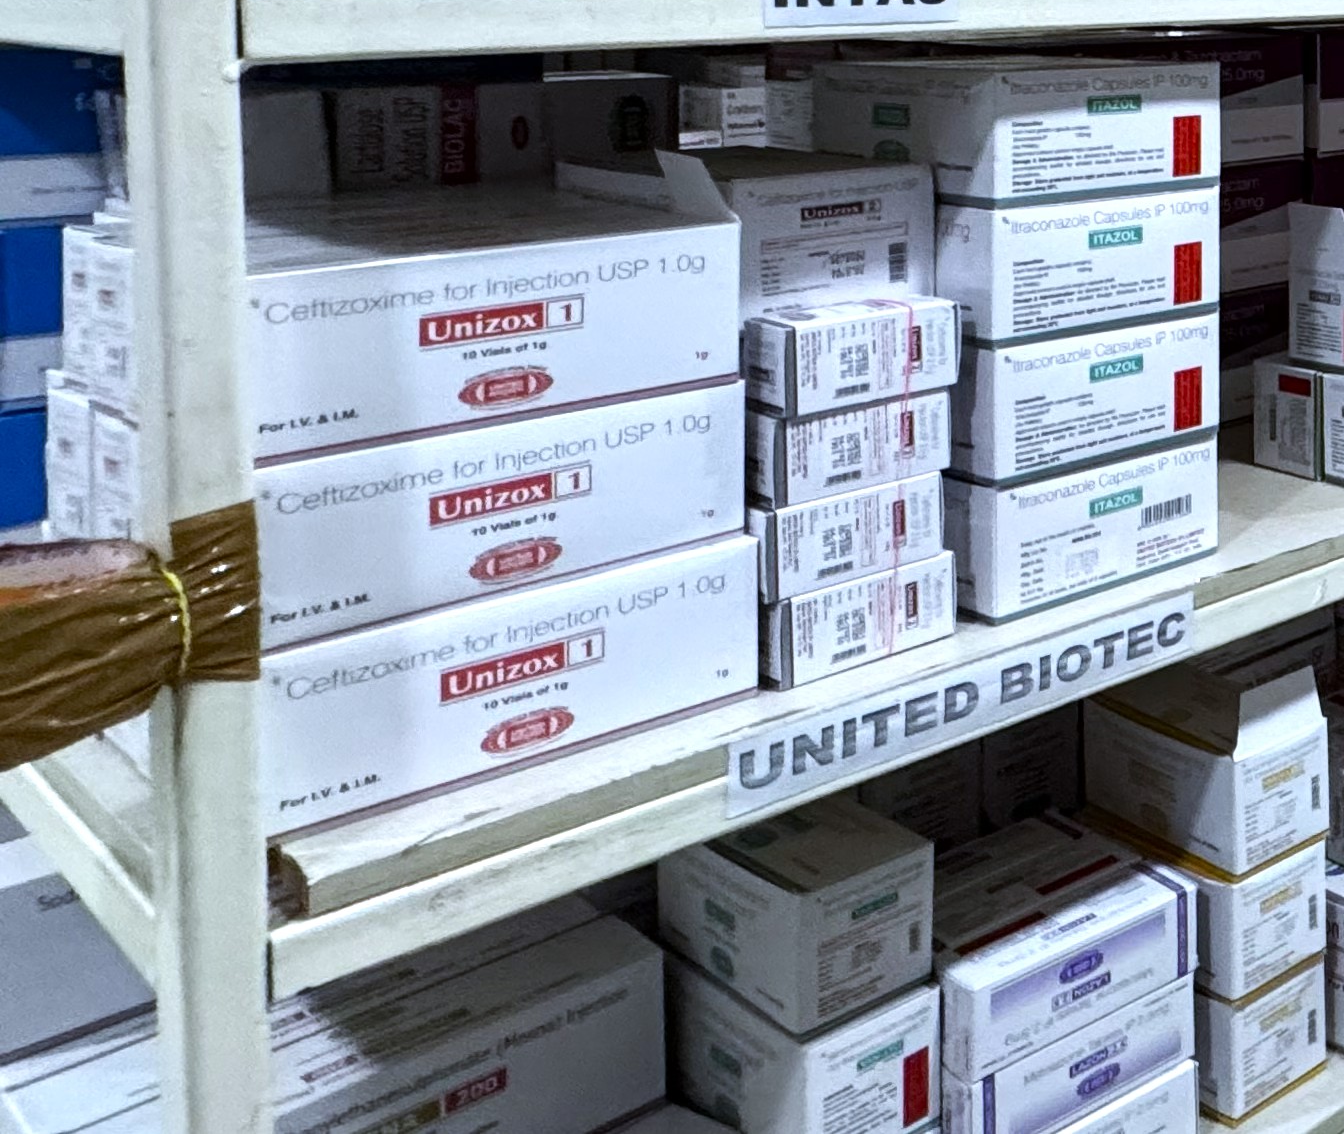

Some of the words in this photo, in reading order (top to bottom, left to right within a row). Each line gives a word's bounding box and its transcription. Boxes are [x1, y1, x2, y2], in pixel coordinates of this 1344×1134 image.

[1092, 77, 1150, 92] Capsules
[1170, 73, 1210, 89] 100mg
[1093, 97, 1137, 111] ITAZOL
[1010, 214, 1090, 234] Itraconazole
[1094, 207, 1151, 226] Capsules
[1170, 199, 1208, 216] 100mg
[1094, 230, 1138, 244] ITAZOL
[265, 288, 434, 324] Ceftizoxime
[444, 282, 478, 300] for
[487, 268, 590, 297] Injection
[600, 260, 648, 282] USP
[660, 254, 705, 278] 1.0g
[428, 308, 538, 342] Unizox
[1013, 347, 1092, 373] Itraconazole
[1094, 336, 1152, 360] Capsules
[1171, 326, 1208, 342] 100mg
[1094, 360, 1139, 378] ITAZOL
[276, 468, 444, 515] Ceftizoxime
[454, 458, 486, 478] for
[495, 436, 596, 470] Injection
[604, 423, 654, 448] USP
[664, 414, 712, 436] 1.0g
[1018, 480, 1095, 508] Itraconazole
[1099, 464, 1155, 488] Capsules
[1174, 448, 1210, 464] 100mg
[437, 482, 547, 520] Unizox
[1094, 493, 1138, 513] ITAZOL
[286, 648, 455, 700] Ceftizoxime
[464, 634, 497, 656] for
[506, 602, 609, 646] Injection
[618, 586, 668, 614] USP
[678, 575, 726, 600] 1.0g
[448, 653, 558, 696] Unizox
[739, 681, 978, 789] UNITED
[1000, 612, 1185, 703] BIOTEC
